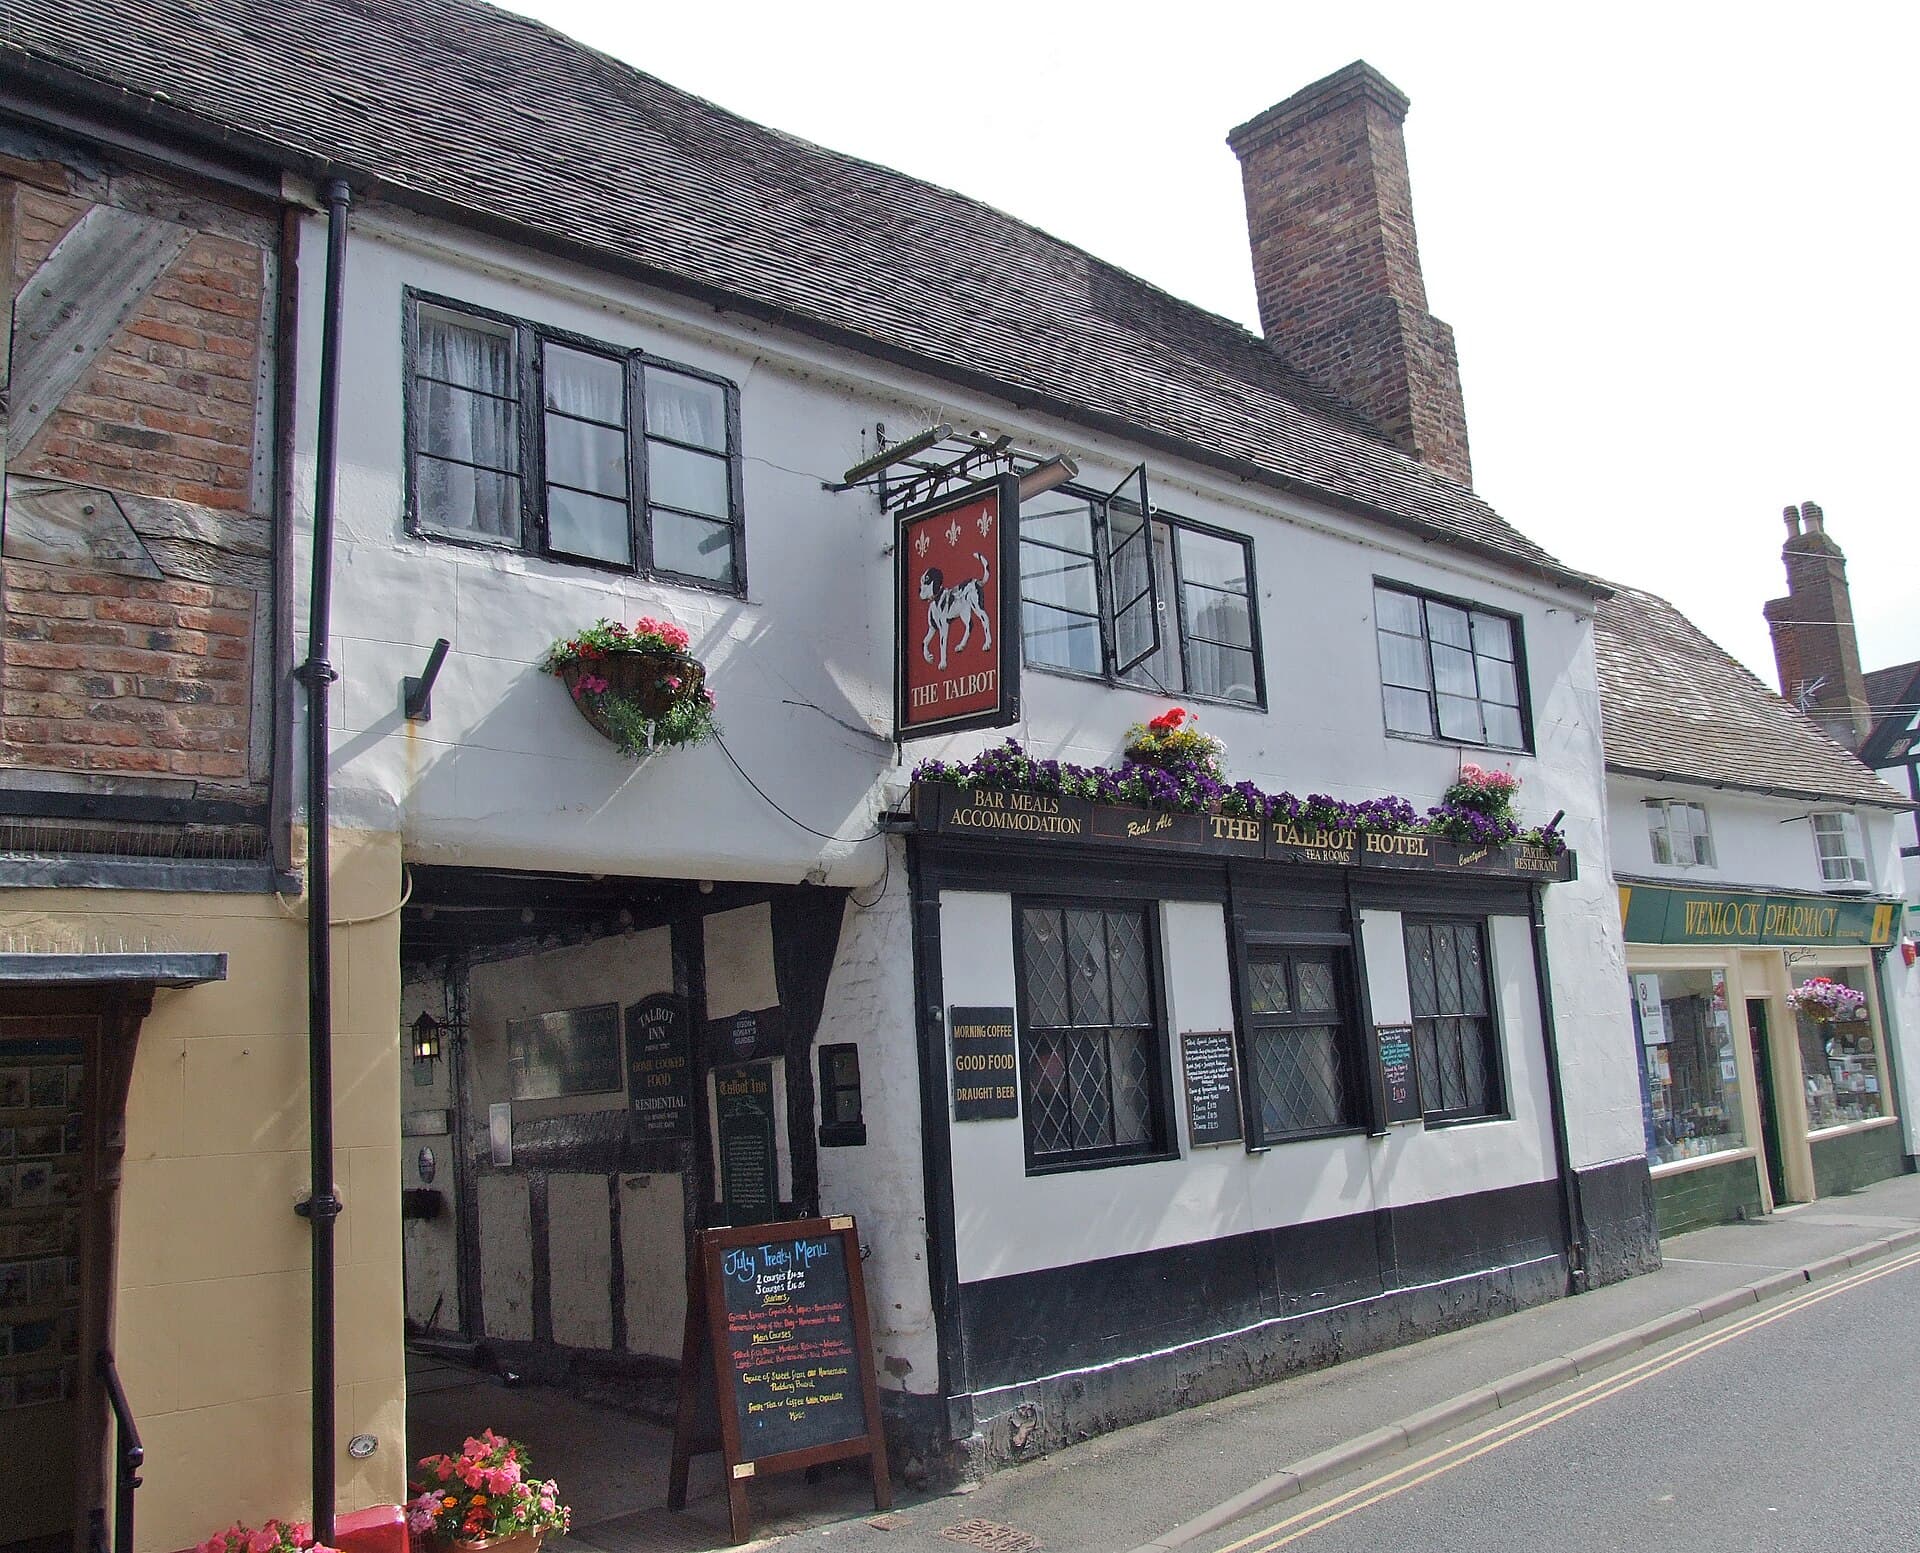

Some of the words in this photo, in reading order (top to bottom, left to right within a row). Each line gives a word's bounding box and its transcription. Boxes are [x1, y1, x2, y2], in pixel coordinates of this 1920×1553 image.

[912, 683, 939, 707] THE
[943, 669, 996, 700] TALBOT
[975, 790, 1004, 808] BAR
[1010, 794, 1059, 813] MEALS
[950, 808, 1081, 834] ACCOMMODATION
[1127, 818, 1151, 838] Real
[1155, 812, 1173, 831] Ale
[1210, 815, 1260, 841] THE
[1273, 823, 1356, 850] TALBOT
[1366, 832, 1429, 857] HOTEL
[1305, 848, 1321, 861] TEA
[1323, 849, 1350, 862] ROOMS
[1514, 857, 1558, 873] RESTAURANT
[1685, 901, 1761, 936] WENLOCK
[1762, 904, 1838, 937] PHARMACY
[640, 1007, 675, 1027] TALBOT
[649, 1026, 665, 1040] INN
[953, 1025, 986, 1038] MORNING
[987, 1025, 1013, 1038] COFFEE
[956, 1055, 986, 1071] GOOD
[988, 1054, 1015, 1070] FOOD
[957, 1087, 993, 1101] DRAUGHT
[996, 1086, 1015, 1099] BEER
[635, 1095, 687, 1111] RESIDENTIAL
[724, 1249, 755, 1282] July
[795, 1240, 829, 1269] Menu
[756, 1274, 762, 1284] 2
[755, 1284, 762, 1295] 3
[752, 1333, 769, 1342] Main
[768, 1330, 792, 1340] Courses
[762, 1371, 770, 1383] of
[770, 1382, 795, 1393] Pudding
